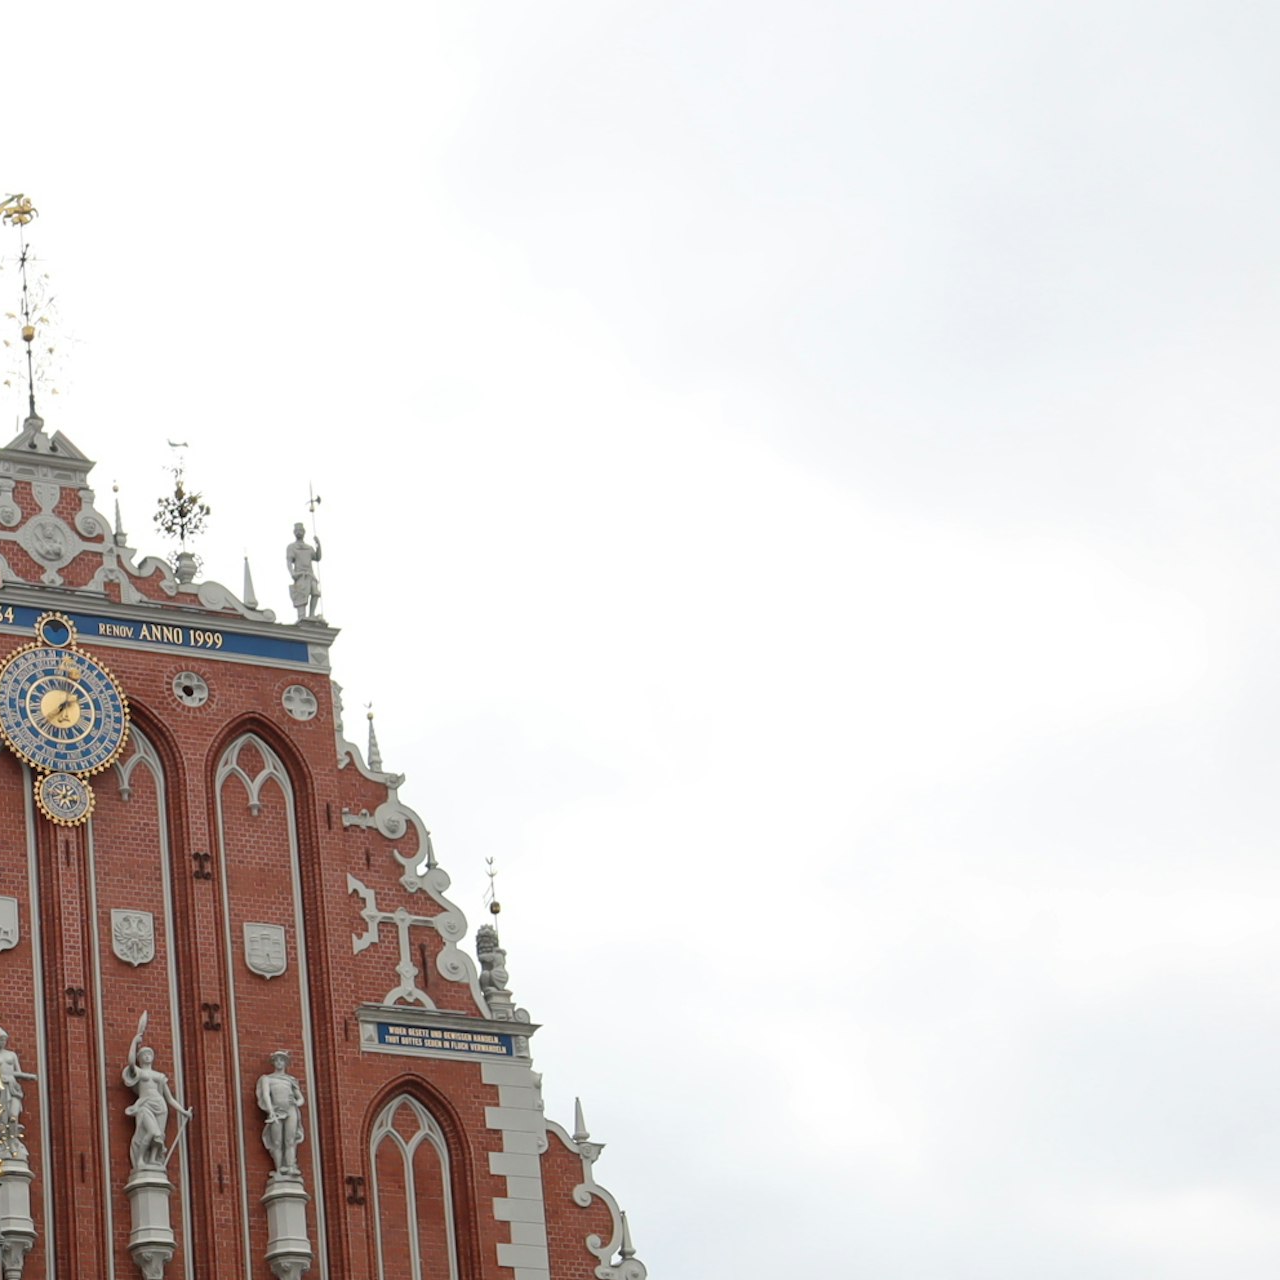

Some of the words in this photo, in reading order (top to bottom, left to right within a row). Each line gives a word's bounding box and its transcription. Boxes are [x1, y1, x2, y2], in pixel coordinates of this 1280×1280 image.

[98, 622, 134, 638] RENOV.
[139, 624, 183, 645] ANNO
[189, 629, 223, 649] 1999
